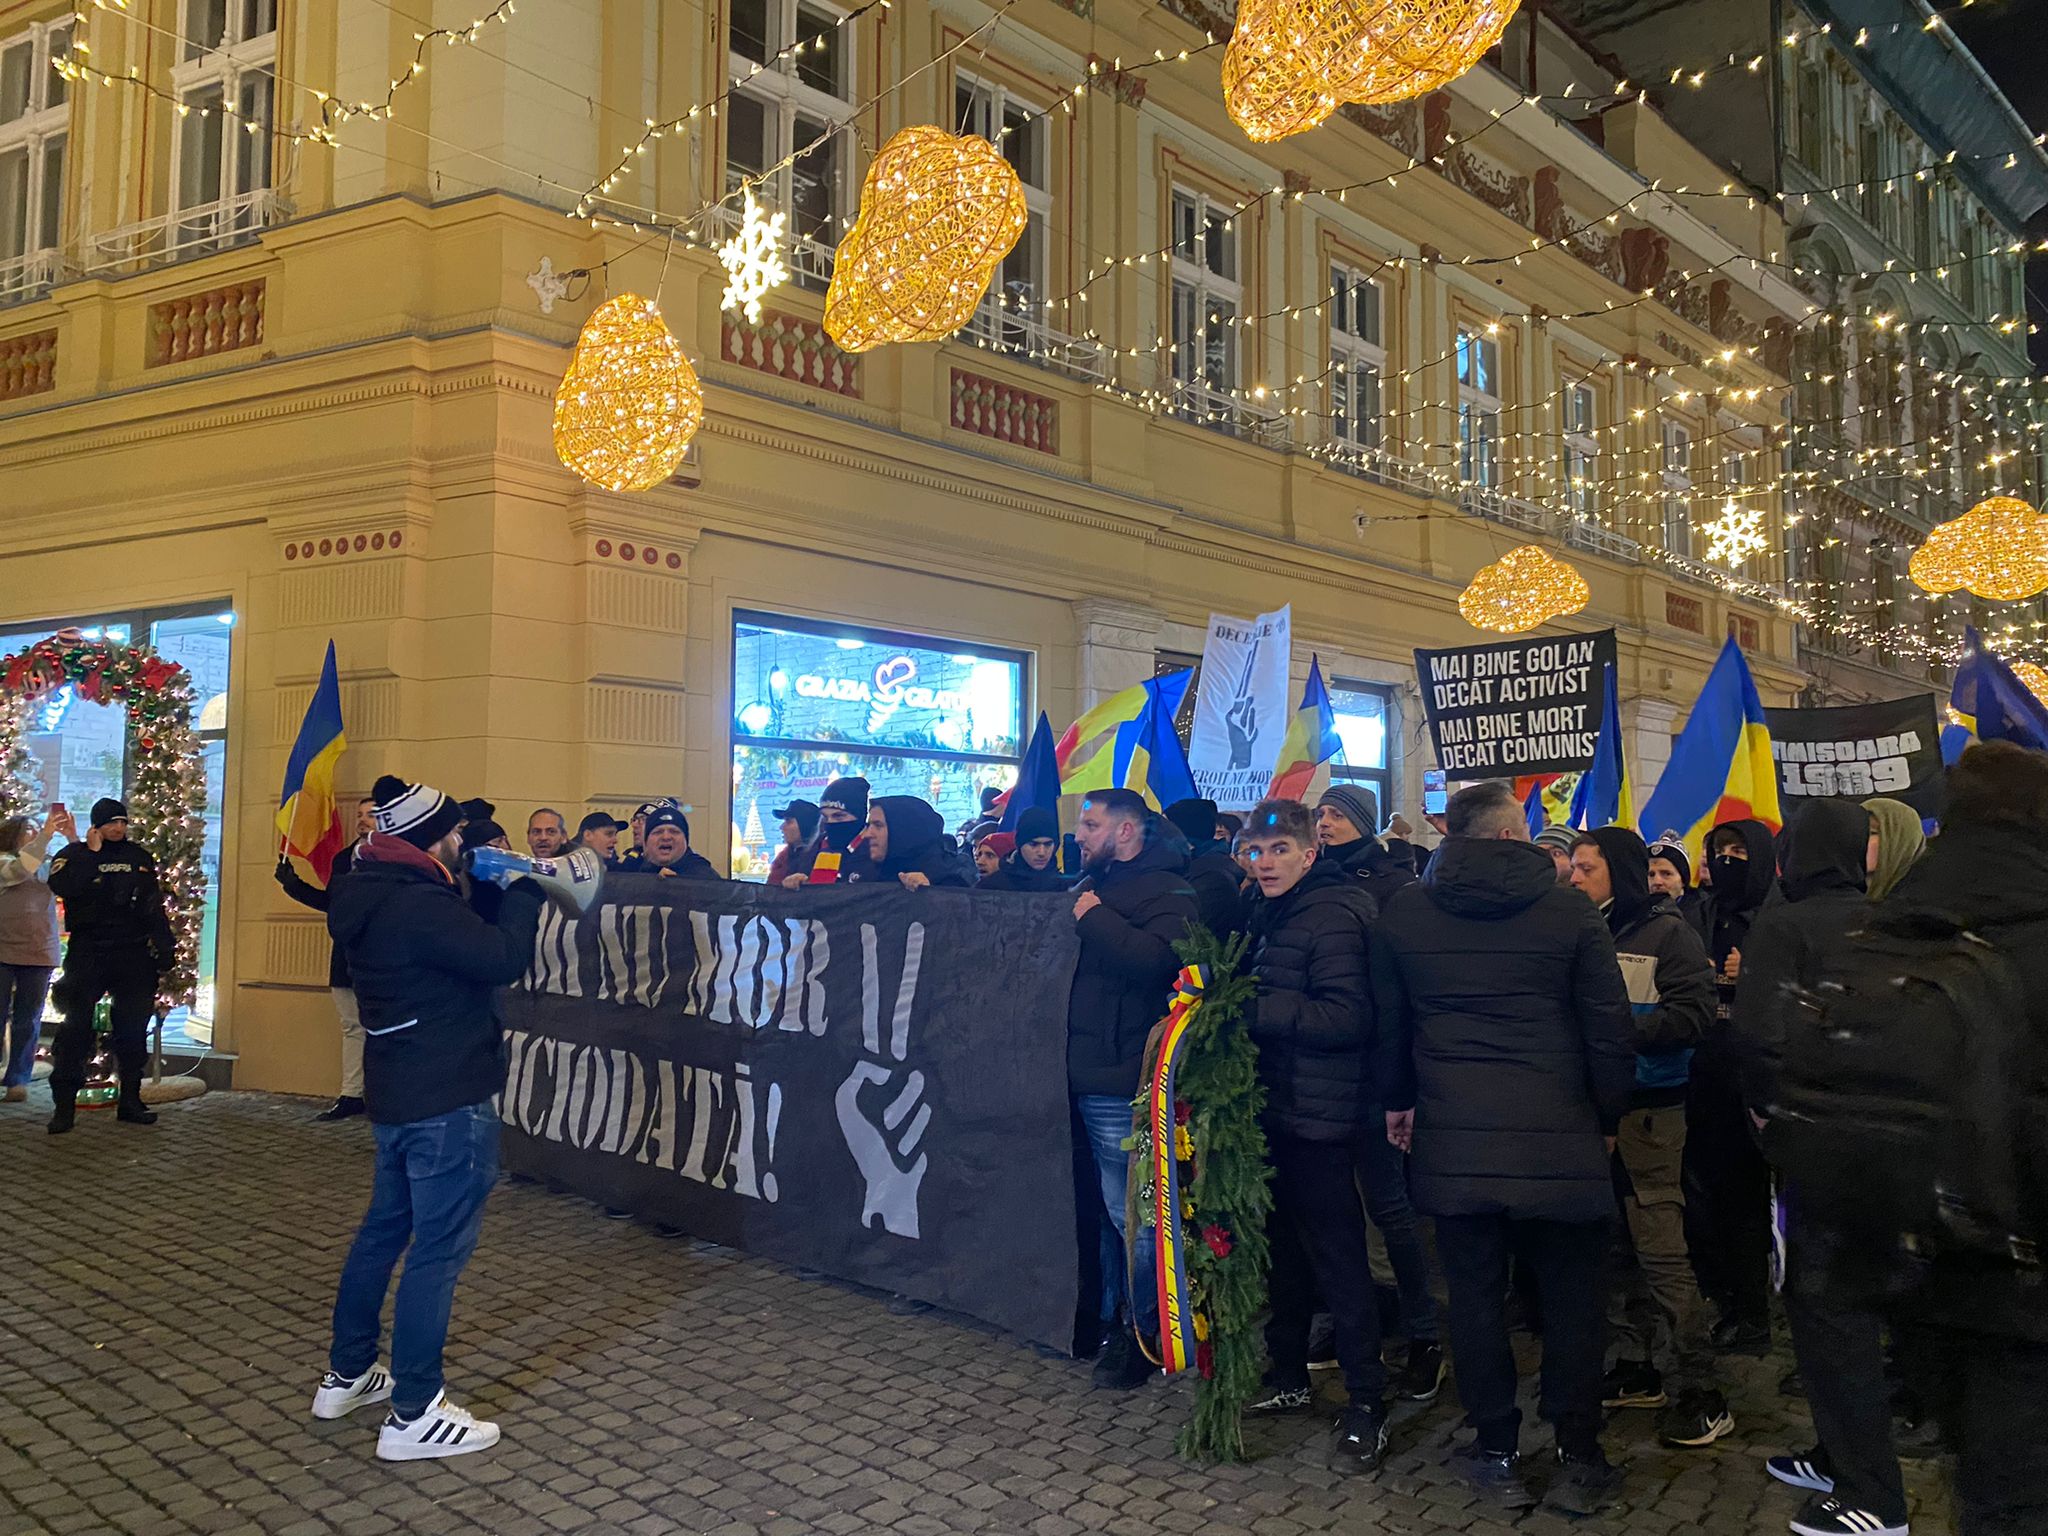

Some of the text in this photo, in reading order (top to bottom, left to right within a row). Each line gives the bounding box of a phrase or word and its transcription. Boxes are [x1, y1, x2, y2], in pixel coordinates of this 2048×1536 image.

[1430, 640, 1596, 682] MAI BINE GOLAN
[1499, 666, 1591, 704] ACTIVIST
[1438, 705, 1588, 745] MAI BINE MORT
[1441, 731, 1600, 771] DECAT COMUNIS
[1782, 756, 1911, 797] 1989
[597, 903, 673, 1009] NU
[683, 909, 830, 1037] MOR
[491, 1029, 783, 1204] ICIODATĂ!
